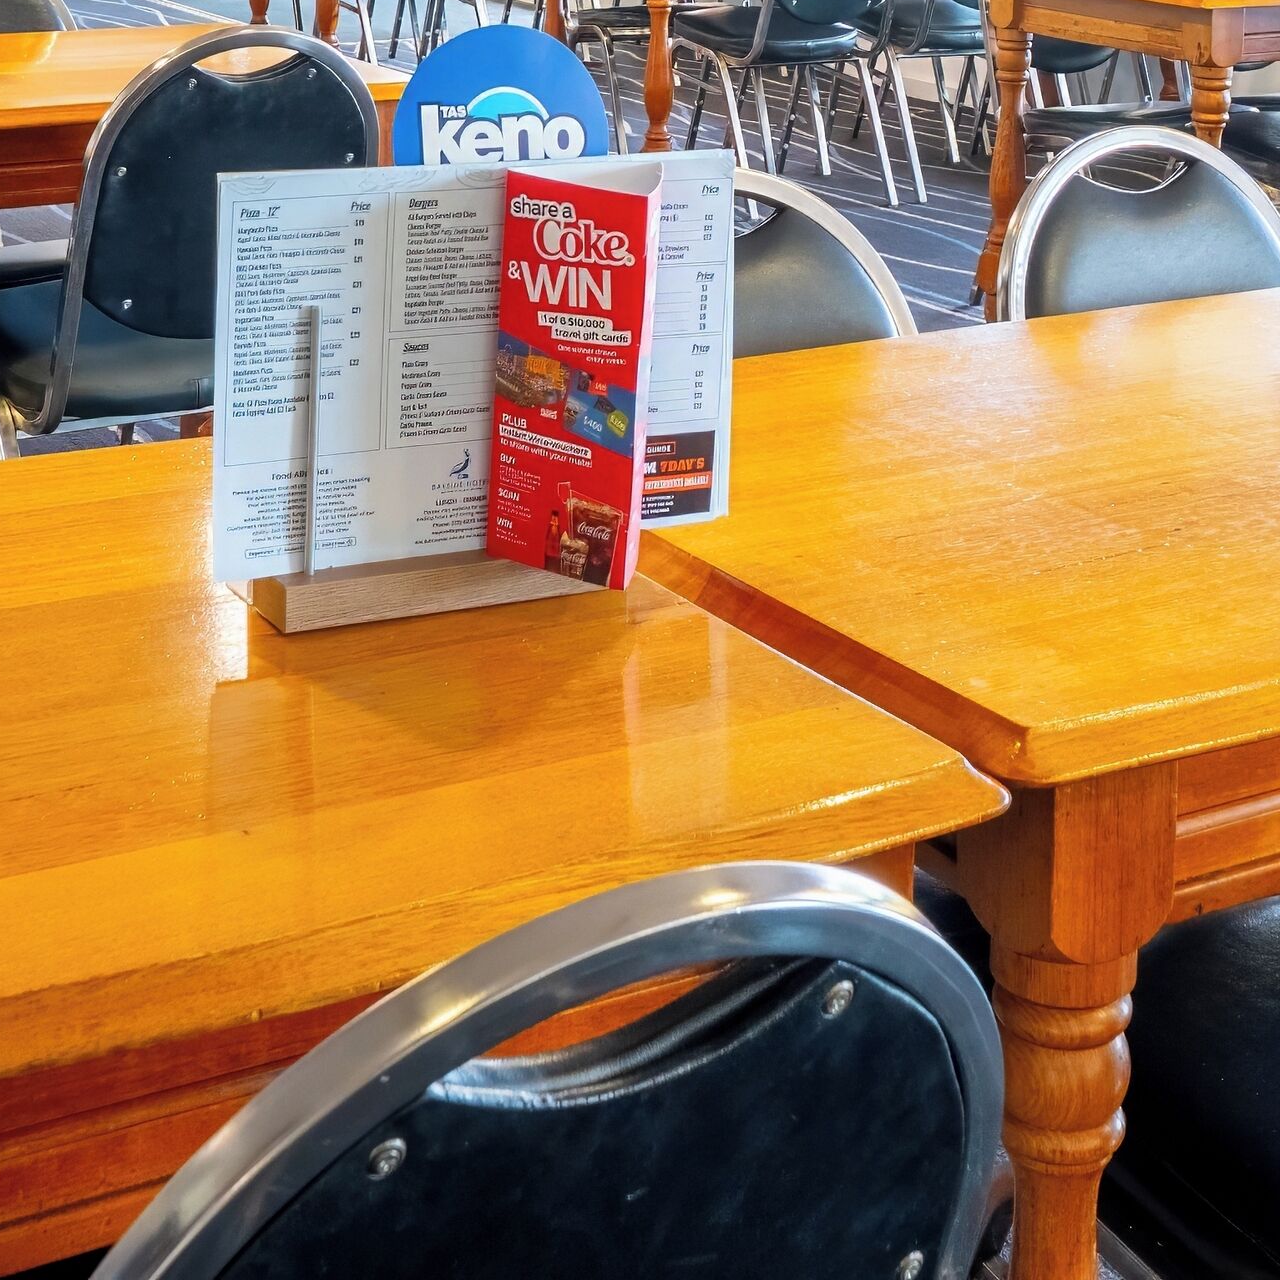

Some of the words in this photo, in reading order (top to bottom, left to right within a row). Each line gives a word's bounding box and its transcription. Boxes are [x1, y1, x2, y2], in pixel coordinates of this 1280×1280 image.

[440, 106, 466, 119] TAS
[421, 104, 585, 165] keno
[350, 201, 371, 212] Price
[513, 196, 558, 217] share
[563, 205, 573, 218] a
[533, 219, 630, 266] Coke
[696, 271, 714, 281] Price
[508, 261, 521, 280] &
[520, 261, 612, 311] WIN
[549, 315, 558, 324] of
[583, 331, 599, 341] gift
